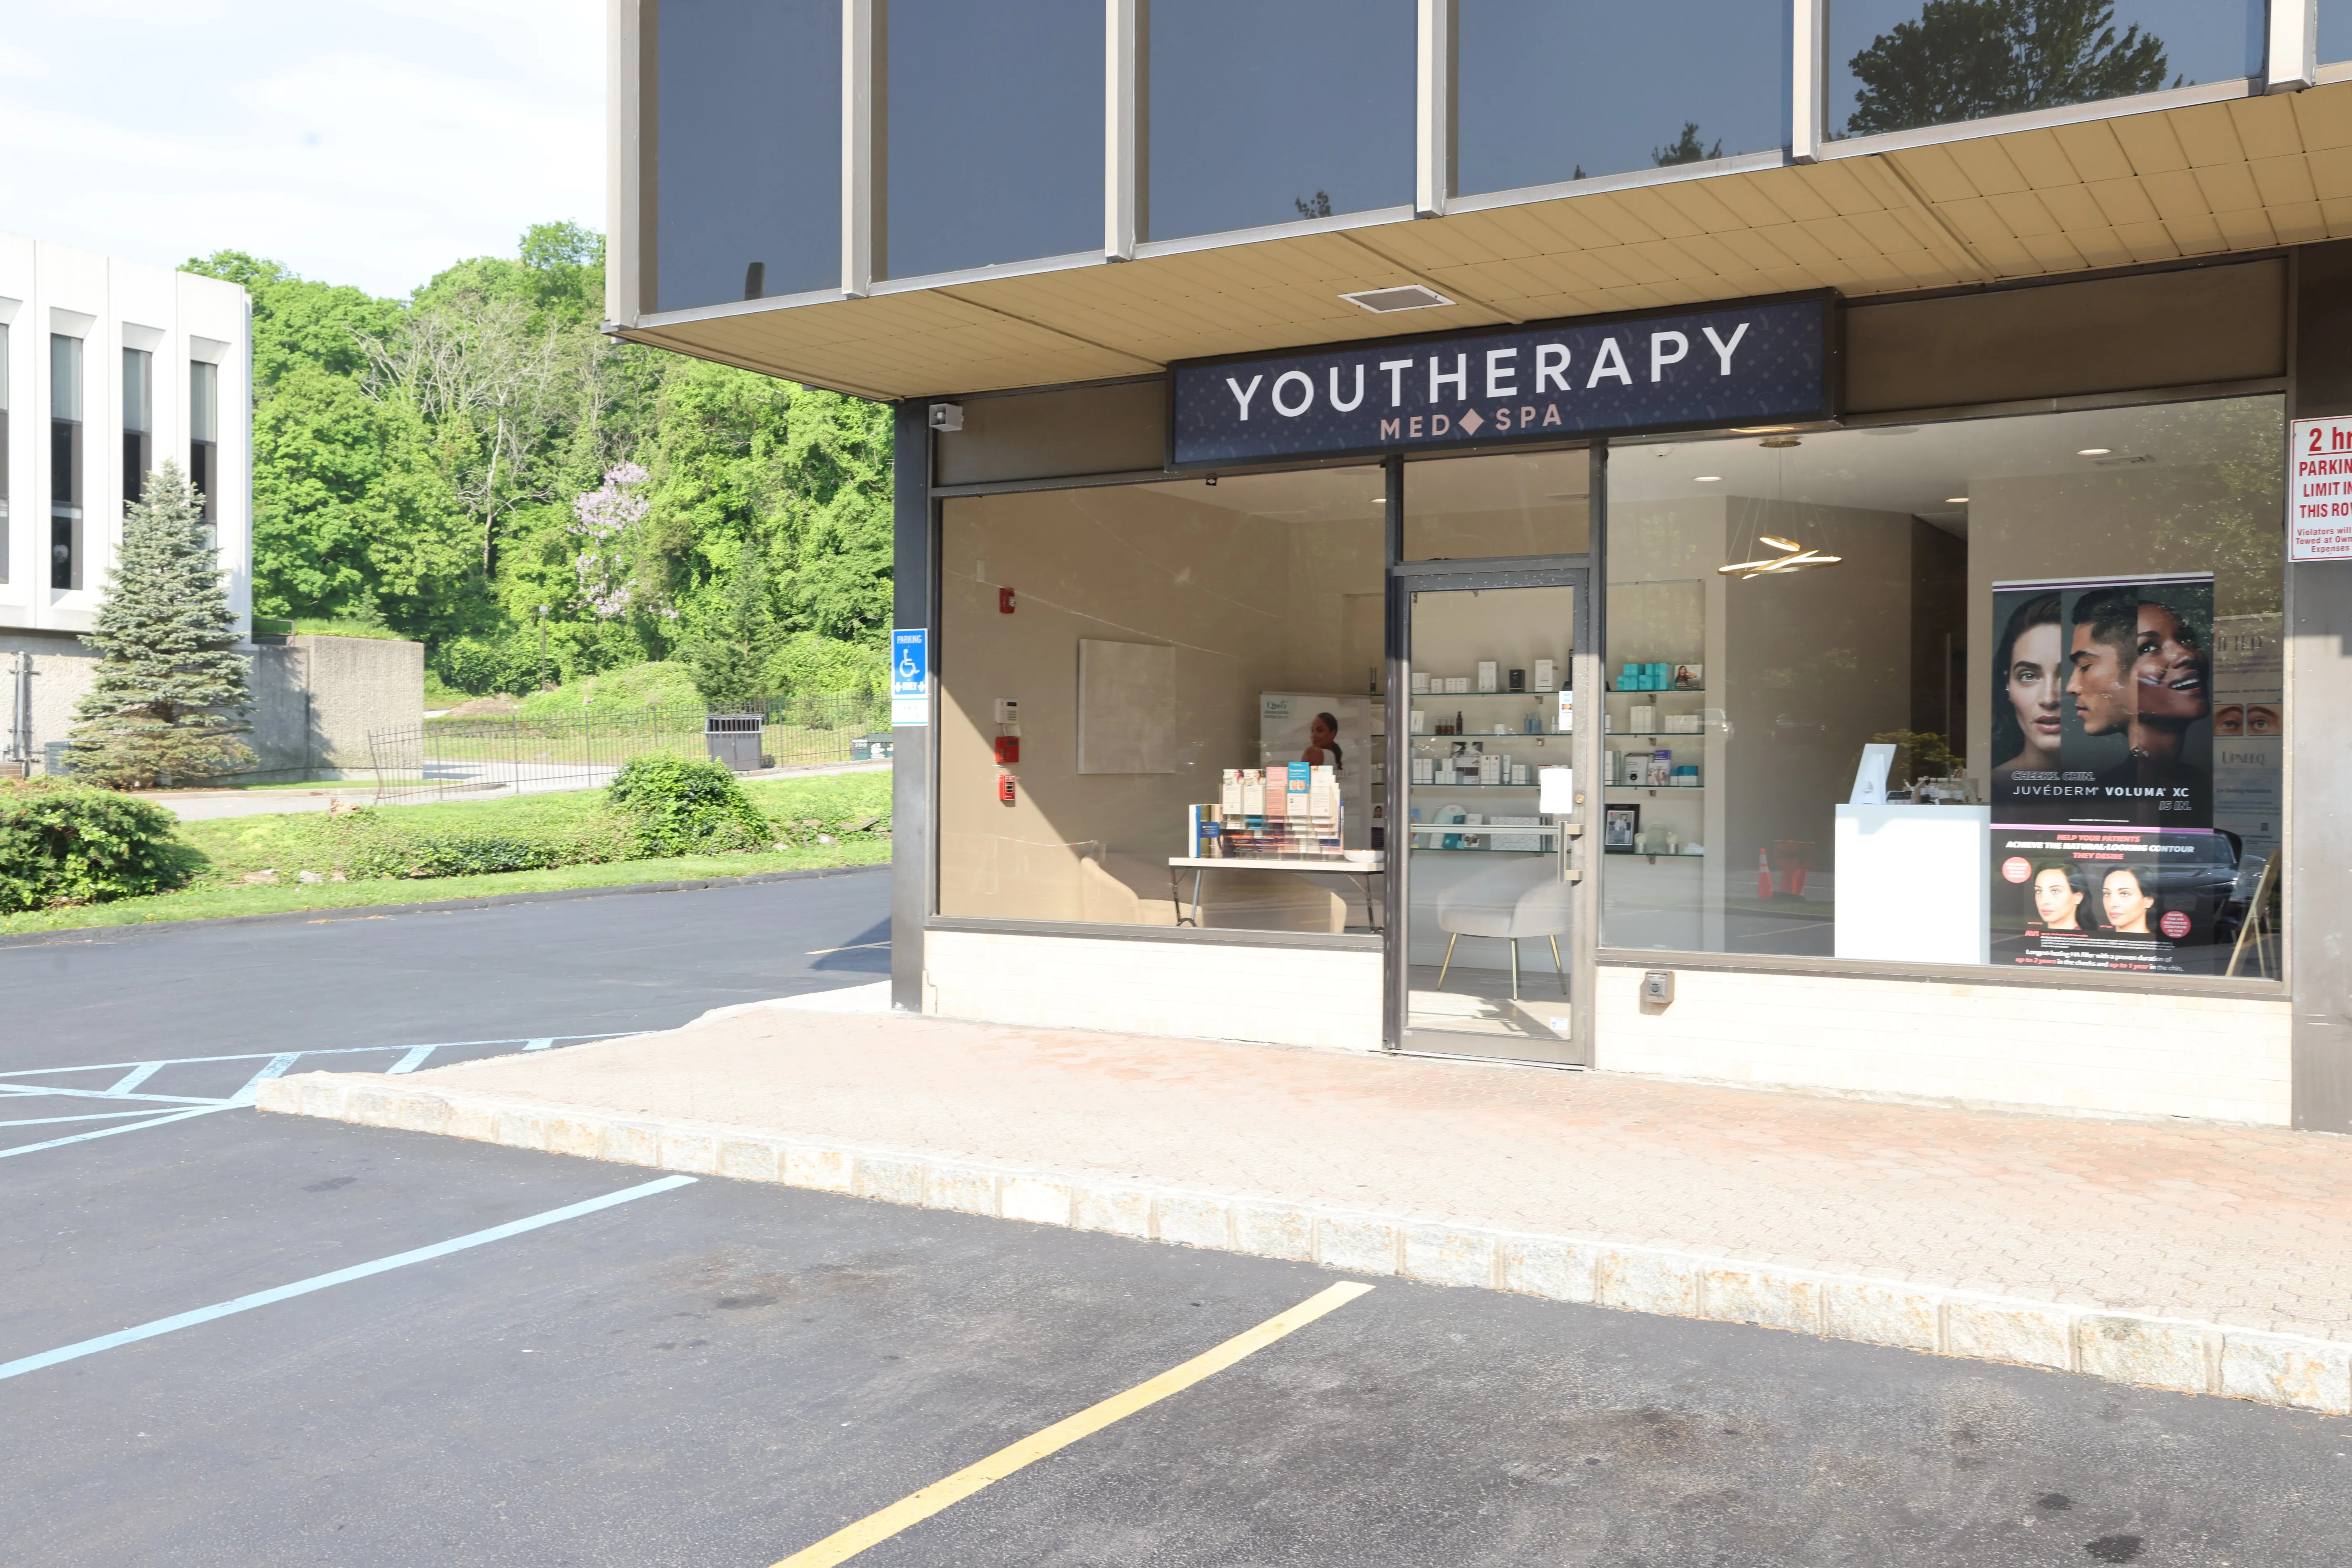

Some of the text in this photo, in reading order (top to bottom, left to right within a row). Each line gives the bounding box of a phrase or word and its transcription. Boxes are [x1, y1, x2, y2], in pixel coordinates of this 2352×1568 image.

[1226, 323, 1749, 421] YOUTHERAPY
[1381, 404, 1562, 441] MED SPA
[2309, 428, 2322, 452] 2
[2299, 458, 2352, 477] PARKIN
[2303, 481, 2352, 497] LIMIT IN
[2300, 502, 2352, 518] THIS RO
[2311, 545, 2350, 554] Expenses
[897, 635, 922, 644] PARKING
[2222, 751, 2268, 766] UPNEEQ
[2173, 788, 2190, 797] XC
[2159, 801, 2173, 810] IS
[2149, 845, 2195, 853] CONTOUR
